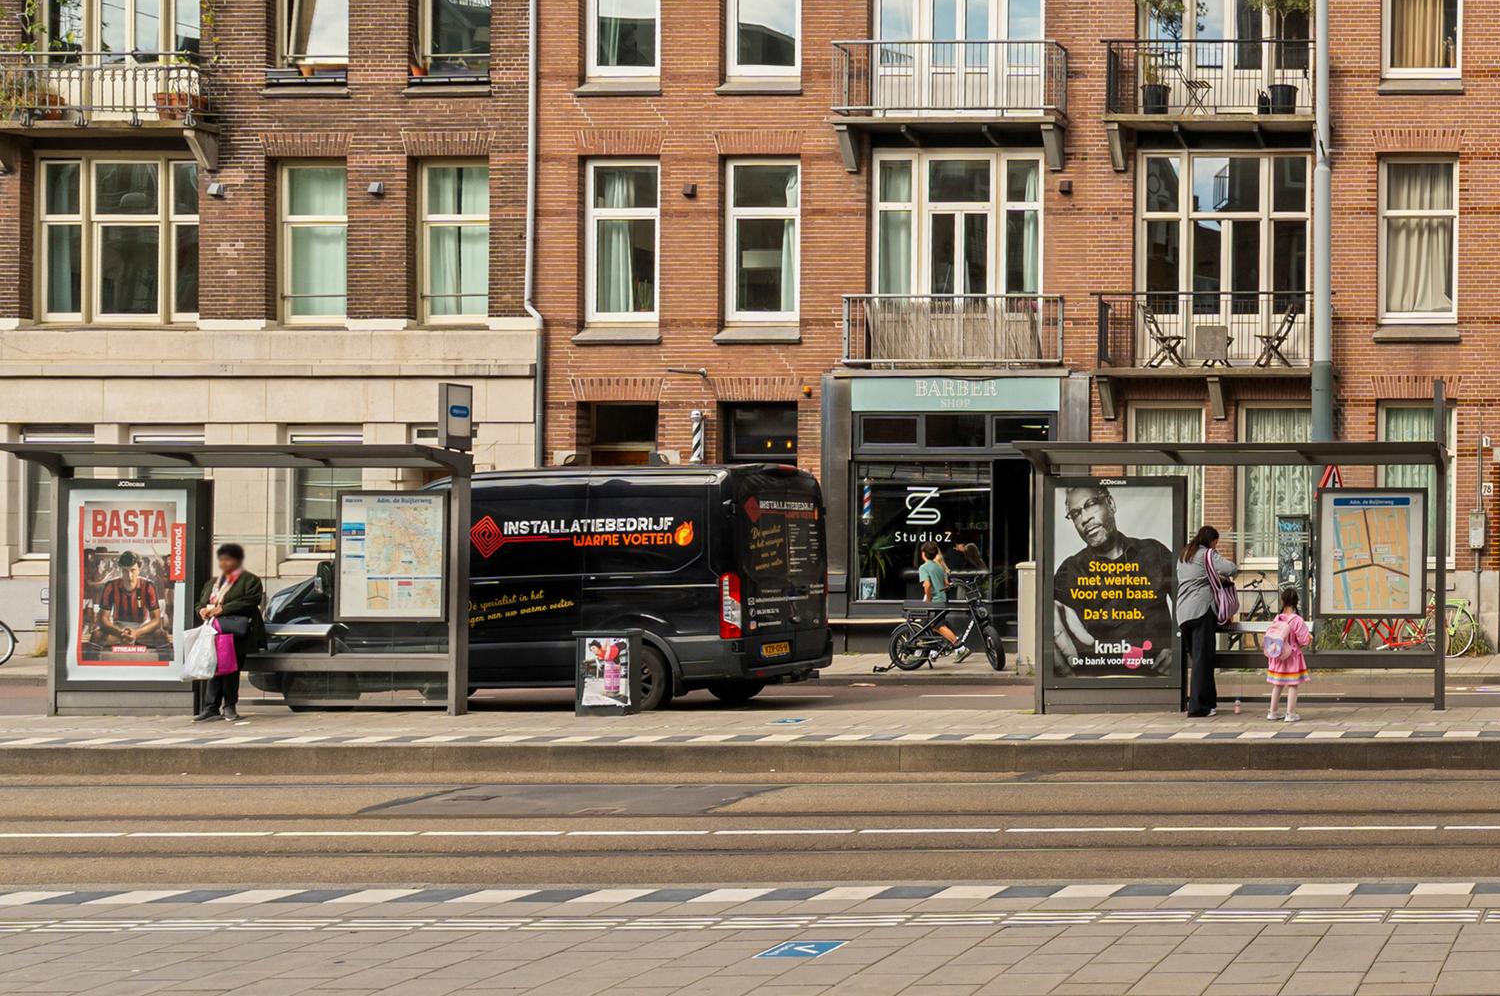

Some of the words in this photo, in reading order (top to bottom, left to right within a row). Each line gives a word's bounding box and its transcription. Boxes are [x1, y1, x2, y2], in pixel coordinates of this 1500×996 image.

[915, 379, 999, 397] BARBER
[941, 399, 970, 408] SHOP
[1483, 485, 1492, 494] 78
[92, 509, 168, 538] BASTA
[503, 517, 674, 535] INSTALLATIEBEDRIJF
[573, 534, 619, 546] WARME
[624, 533, 673, 545] VOETEN
[1089, 561, 1139, 574] Stoppen
[1077, 576, 1101, 586] met
[1104, 574, 1151, 586] werken.
[480, 594, 518, 611] specialist
[519, 594, 529, 602] in
[531, 589, 545, 600] het
[1070, 588, 1099, 599] Voor
[1101, 590, 1123, 599] een
[1126, 588, 1157, 599] baas.
[487, 612, 503, 620] van
[520, 605, 548, 615] warme
[549, 598, 576, 610] voeten
[1084, 609, 1108, 620] Da's
[1112, 608, 1145, 620] knab.
[1095, 640, 1131, 654] knab
[1072, 657, 1084, 665] De
[1085, 657, 1106, 665] bank
[1126, 657, 1154, 666] zzp'ers
